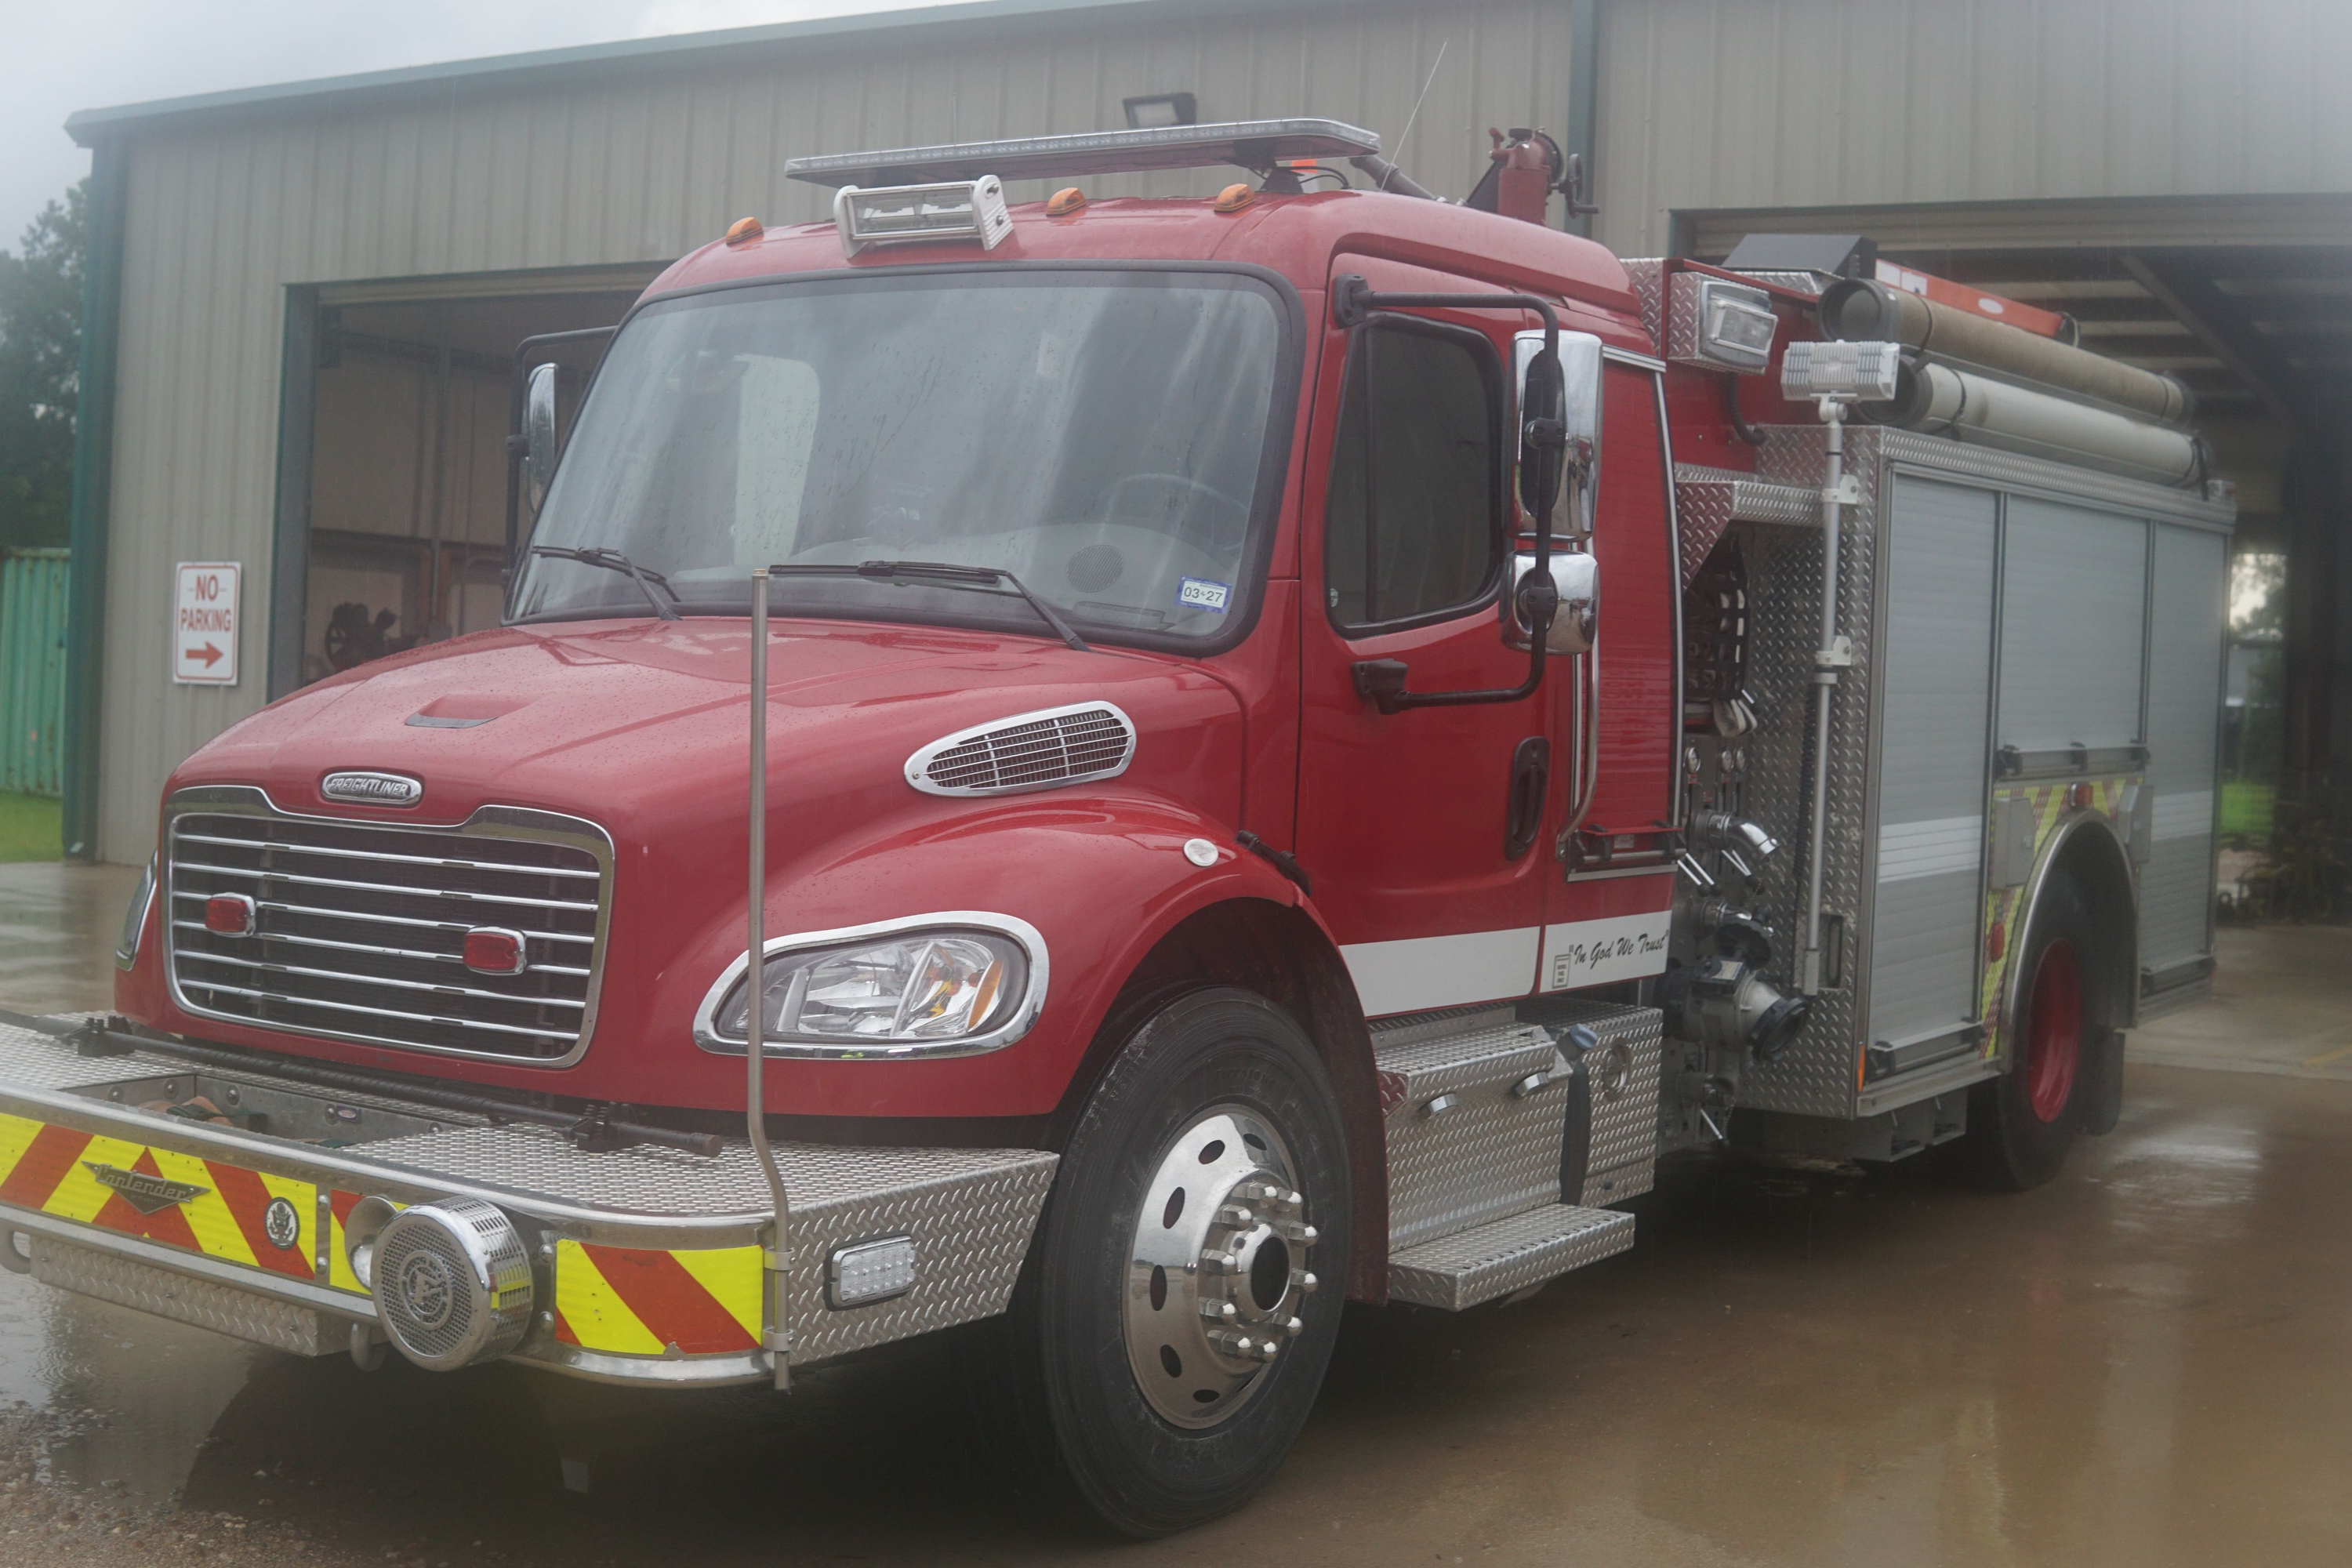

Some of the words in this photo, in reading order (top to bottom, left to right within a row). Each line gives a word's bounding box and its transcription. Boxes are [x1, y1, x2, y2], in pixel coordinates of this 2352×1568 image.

[195, 575, 219, 601] NO
[180, 608, 232, 633] PARKING
[327, 778, 408, 797] FREIGHTLINER
[1590, 941, 1614, 970] God
[1617, 937, 1635, 956] We
[96, 1163, 191, 1203] Contender
